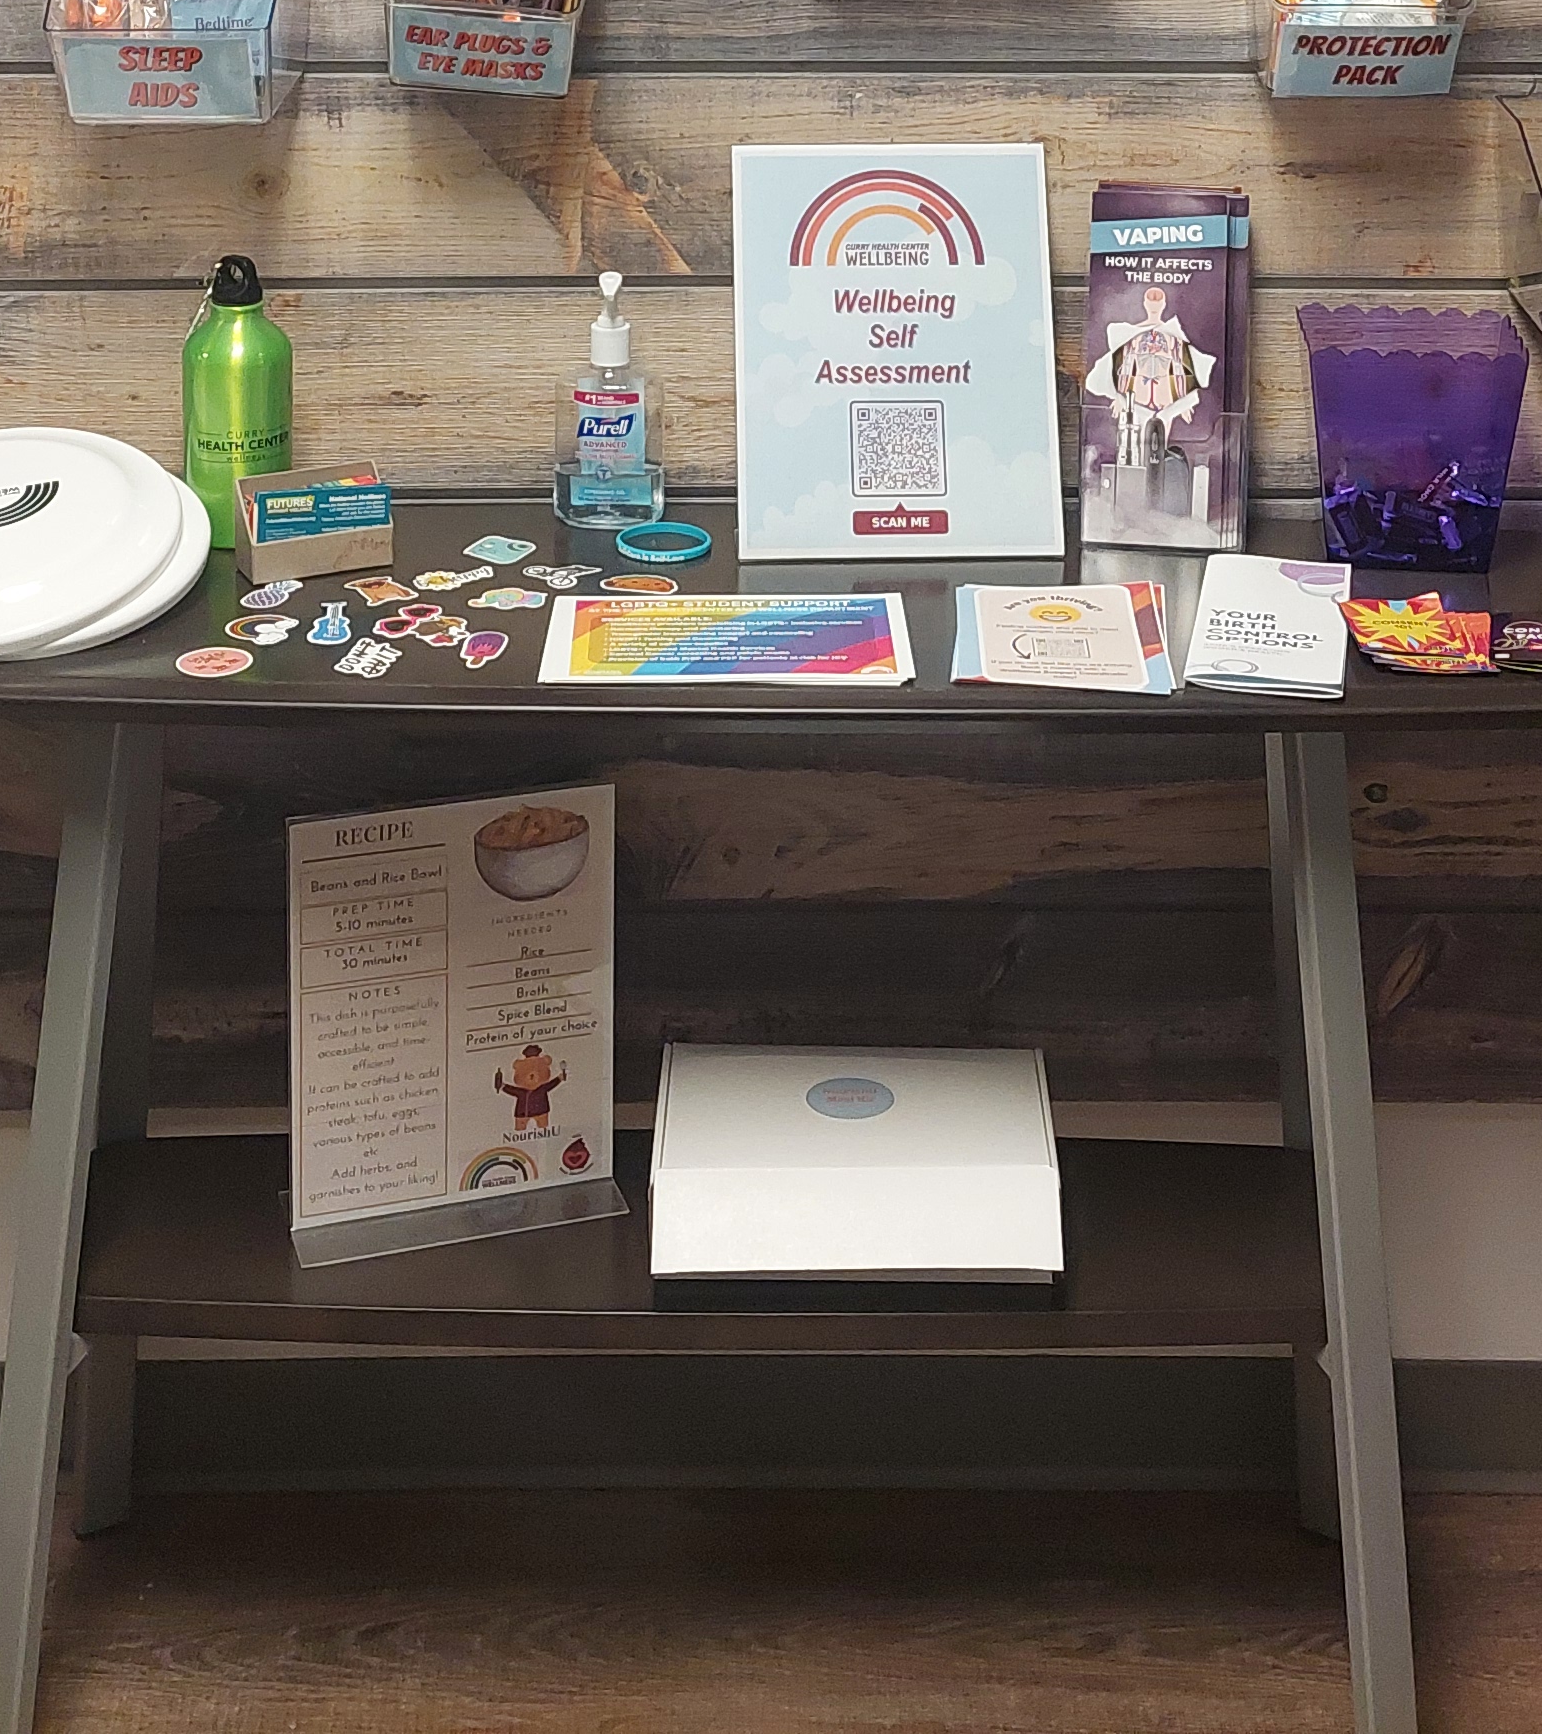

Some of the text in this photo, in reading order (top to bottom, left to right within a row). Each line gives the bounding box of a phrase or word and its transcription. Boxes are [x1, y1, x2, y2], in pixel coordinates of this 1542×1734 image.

[405, 25, 553, 57] EAR PLUGS &
[1292, 34, 1452, 57] PROTECTION
[118, 46, 203, 72] SLEEP
[418, 52, 546, 81] EYE MASKS
[1332, 65, 1404, 85] PACK
[128, 82, 200, 108] AIDS
[1113, 224, 1204, 247] VAPING
[845, 251, 929, 266] WELLBEING
[1105, 256, 1213, 271] HOW IT AFFECTS
[1125, 271, 1192, 284] THE BODY
[834, 289, 956, 319] Wellbeing
[869, 324, 918, 349] Self
[815, 359, 972, 385] Assessment
[583, 418, 629, 436] Purell
[197, 438, 245, 452] HEALTH
[583, 440, 627, 449] ADVANCED
[266, 496, 314, 510] FUTURES
[871, 516, 930, 529] SCAN ME
[683, 600, 767, 608] STUDENT
[769, 599, 851, 608] SUPPORT
[1208, 618, 1277, 630] BIRTH
[1210, 608, 1277, 622] YOUR
[1204, 635, 1315, 650] OPTIONS
[1205, 628, 1324, 641] CONTROL
[335, 821, 413, 847] RECIPE
[311, 866, 443, 893] Beans and Rice Bowl
[324, 937, 423, 958] TOTAL TIME
[465, 1019, 598, 1046] Protein of your choice
[502, 1125, 561, 1144] NourishU
